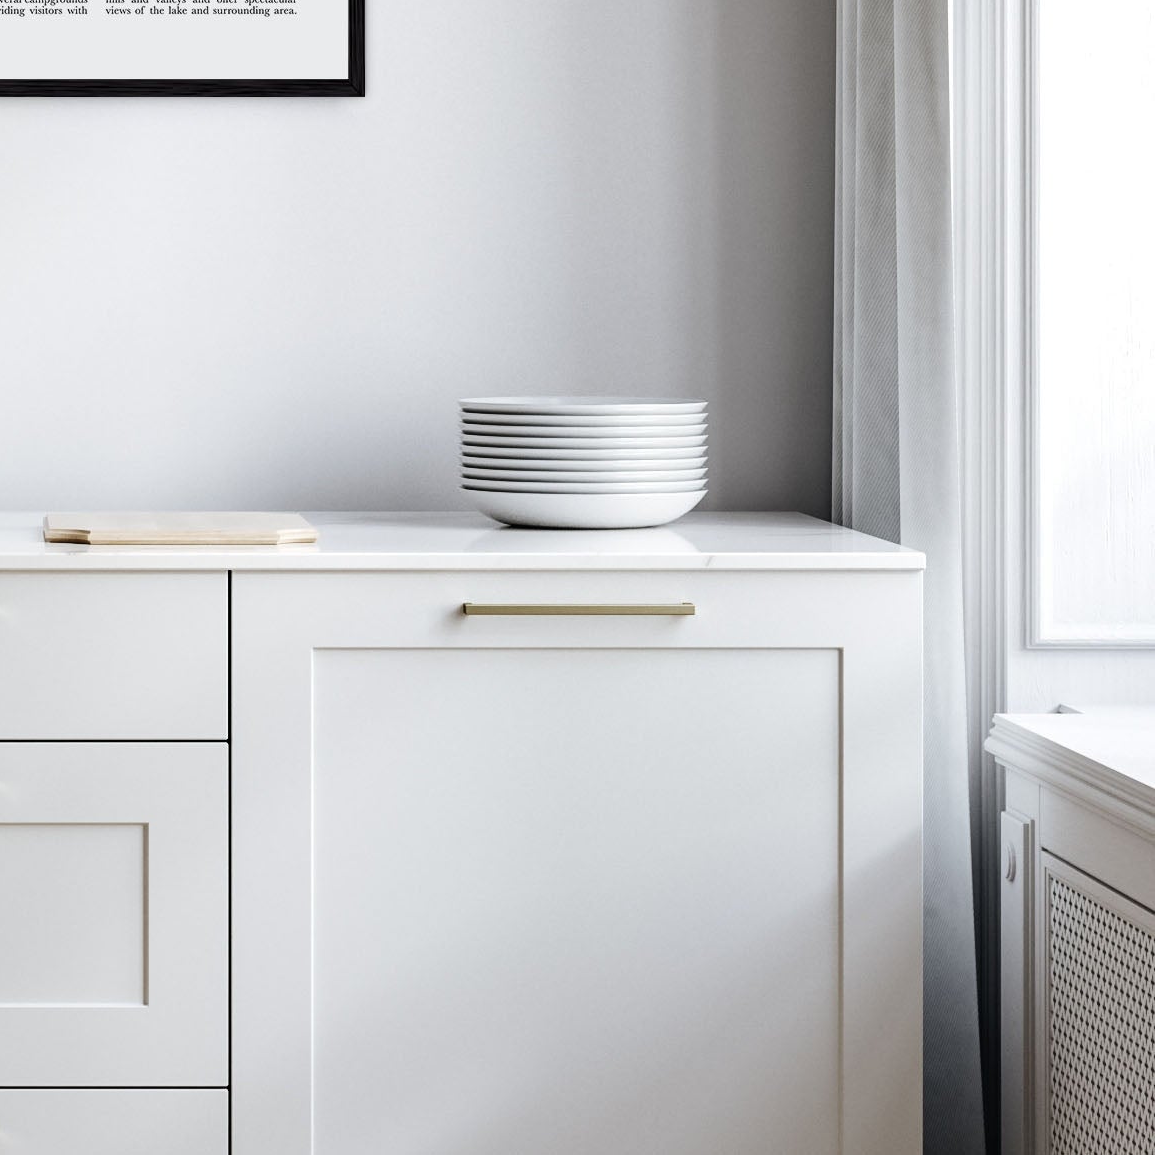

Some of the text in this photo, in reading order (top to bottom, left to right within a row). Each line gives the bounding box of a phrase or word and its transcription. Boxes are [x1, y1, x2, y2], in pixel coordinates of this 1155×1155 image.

[29, 6, 63, 15] visitors
[67, 6, 88, 15] with
[105, 6, 131, 15] views
[134, 6, 145, 15] of
[150, 6, 165, 15] the
[168, 6, 188, 15] lake
[191, 6, 209, 15] and
[213, 6, 270, 17] surrounding
